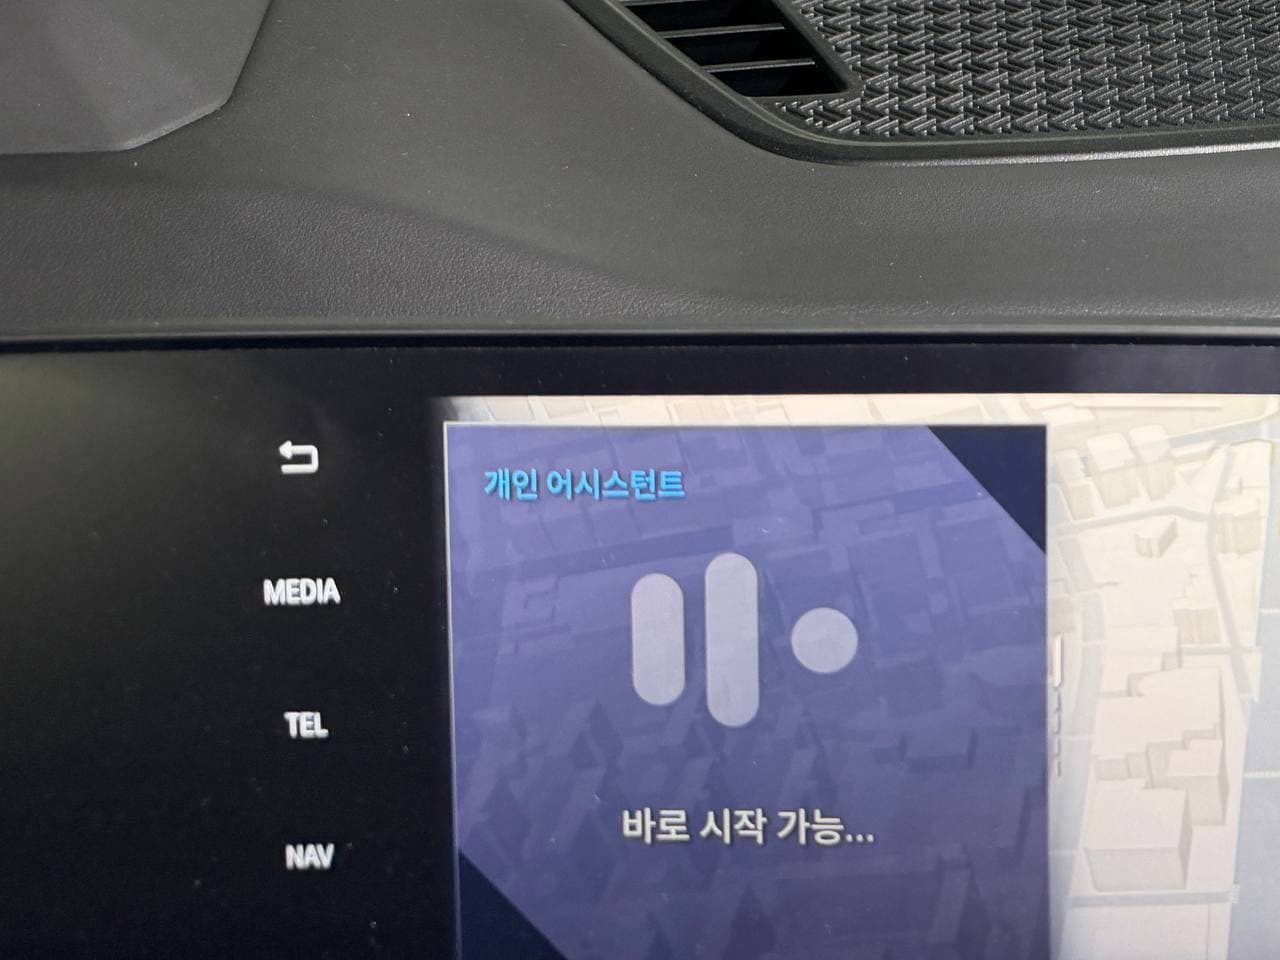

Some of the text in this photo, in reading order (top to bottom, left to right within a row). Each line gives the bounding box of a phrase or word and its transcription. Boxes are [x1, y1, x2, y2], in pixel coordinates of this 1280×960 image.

[484, 467, 686, 501] 개인 어시스턴트
[263, 578, 341, 605] MEDIA
[283, 711, 329, 738] TEL
[622, 807, 875, 845] 바로 시작 가능...
[285, 843, 335, 870] NAV
